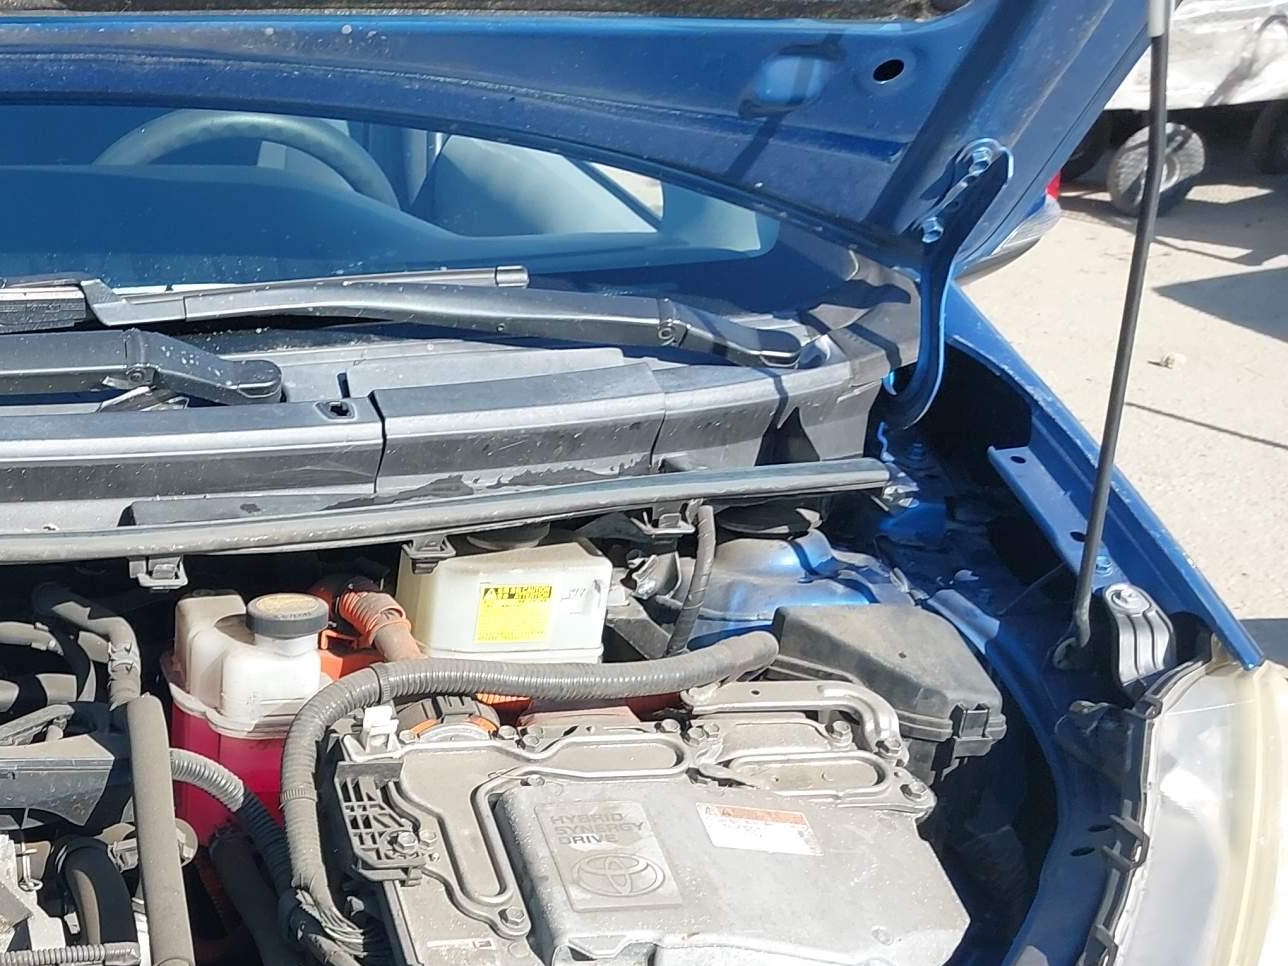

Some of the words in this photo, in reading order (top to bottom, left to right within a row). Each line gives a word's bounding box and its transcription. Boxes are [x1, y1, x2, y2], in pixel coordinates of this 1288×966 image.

[550, 813, 624, 825] HYBRID
[554, 822, 644, 836] SYNERGY
[558, 833, 617, 845] DRIVE
